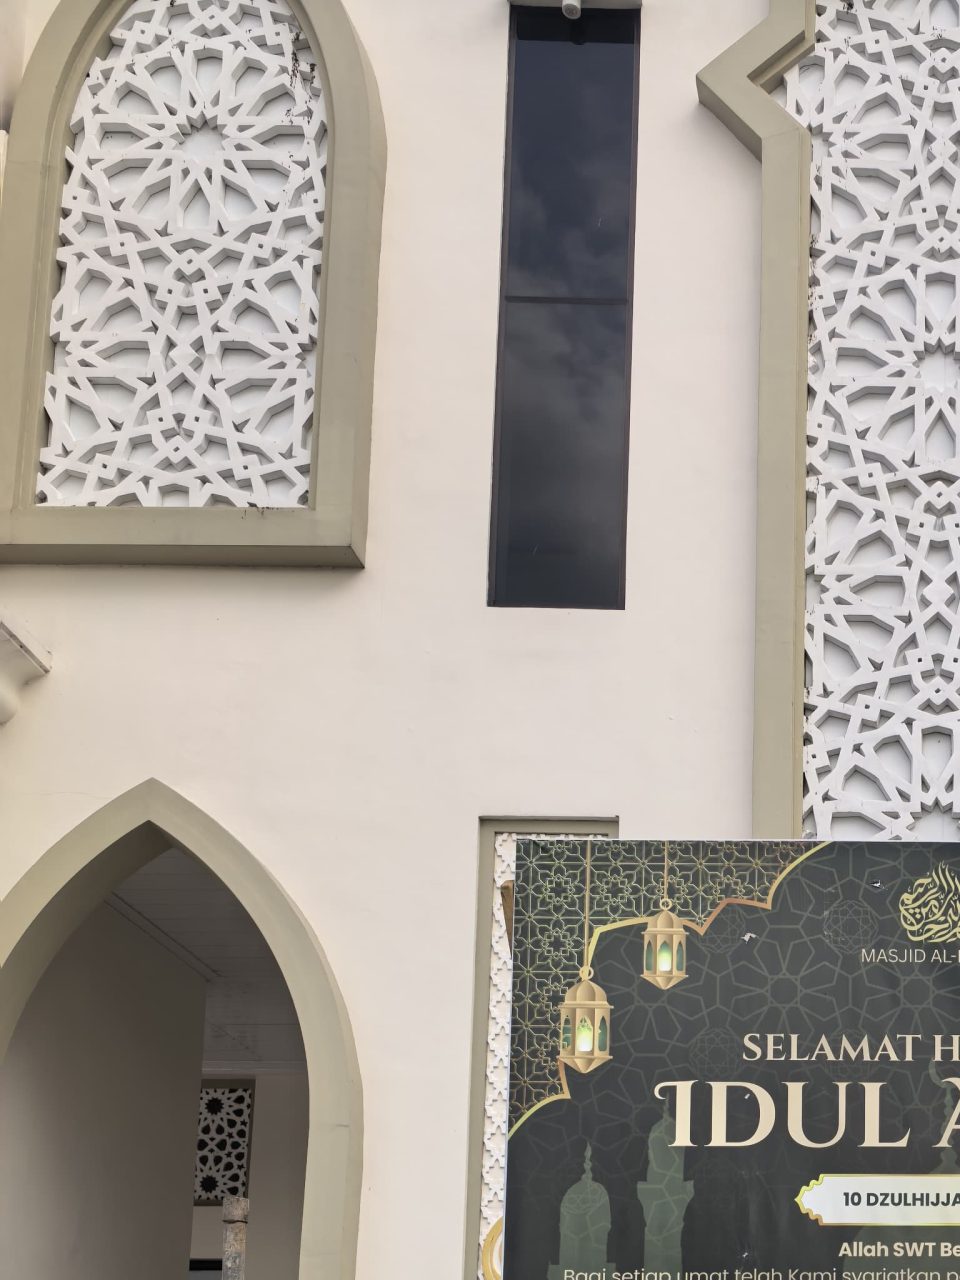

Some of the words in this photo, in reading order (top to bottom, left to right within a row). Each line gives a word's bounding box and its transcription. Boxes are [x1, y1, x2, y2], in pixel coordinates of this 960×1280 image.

[861, 948, 926, 963] MASJID
[742, 1033, 922, 1062] SELAMAT
[653, 1079, 911, 1148] IDUL
[843, 1191, 862, 1207] 10
[838, 1241, 889, 1257] Allah
[893, 1242, 937, 1257] SWT
